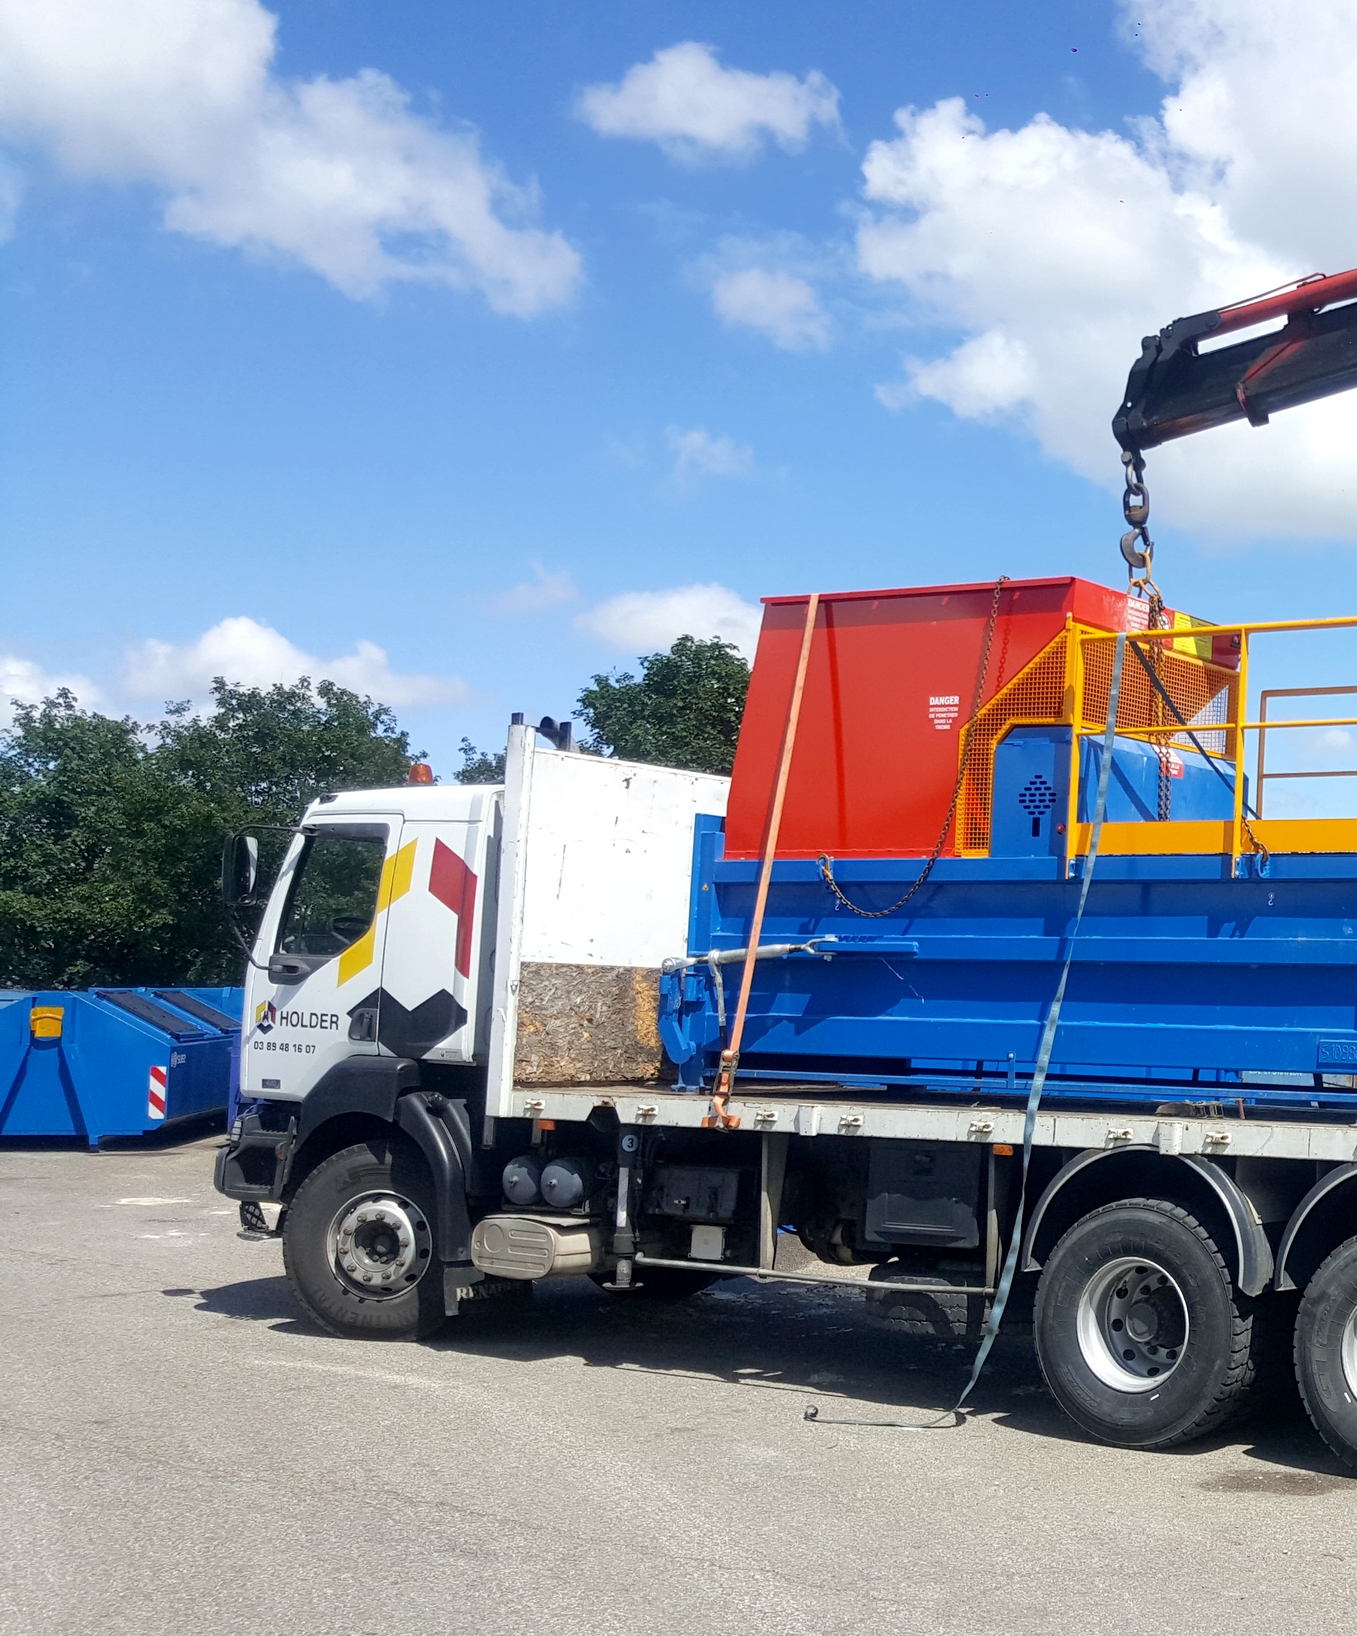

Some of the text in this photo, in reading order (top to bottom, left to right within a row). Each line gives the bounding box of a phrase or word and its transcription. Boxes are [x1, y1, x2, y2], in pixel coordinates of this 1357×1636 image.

[929, 695, 960, 706] DANGER
[280, 1010, 339, 1031] HOLDER
[253, 1041, 316, 1055] 03 89 48 16 07
[627, 1137, 635, 1149] 3
